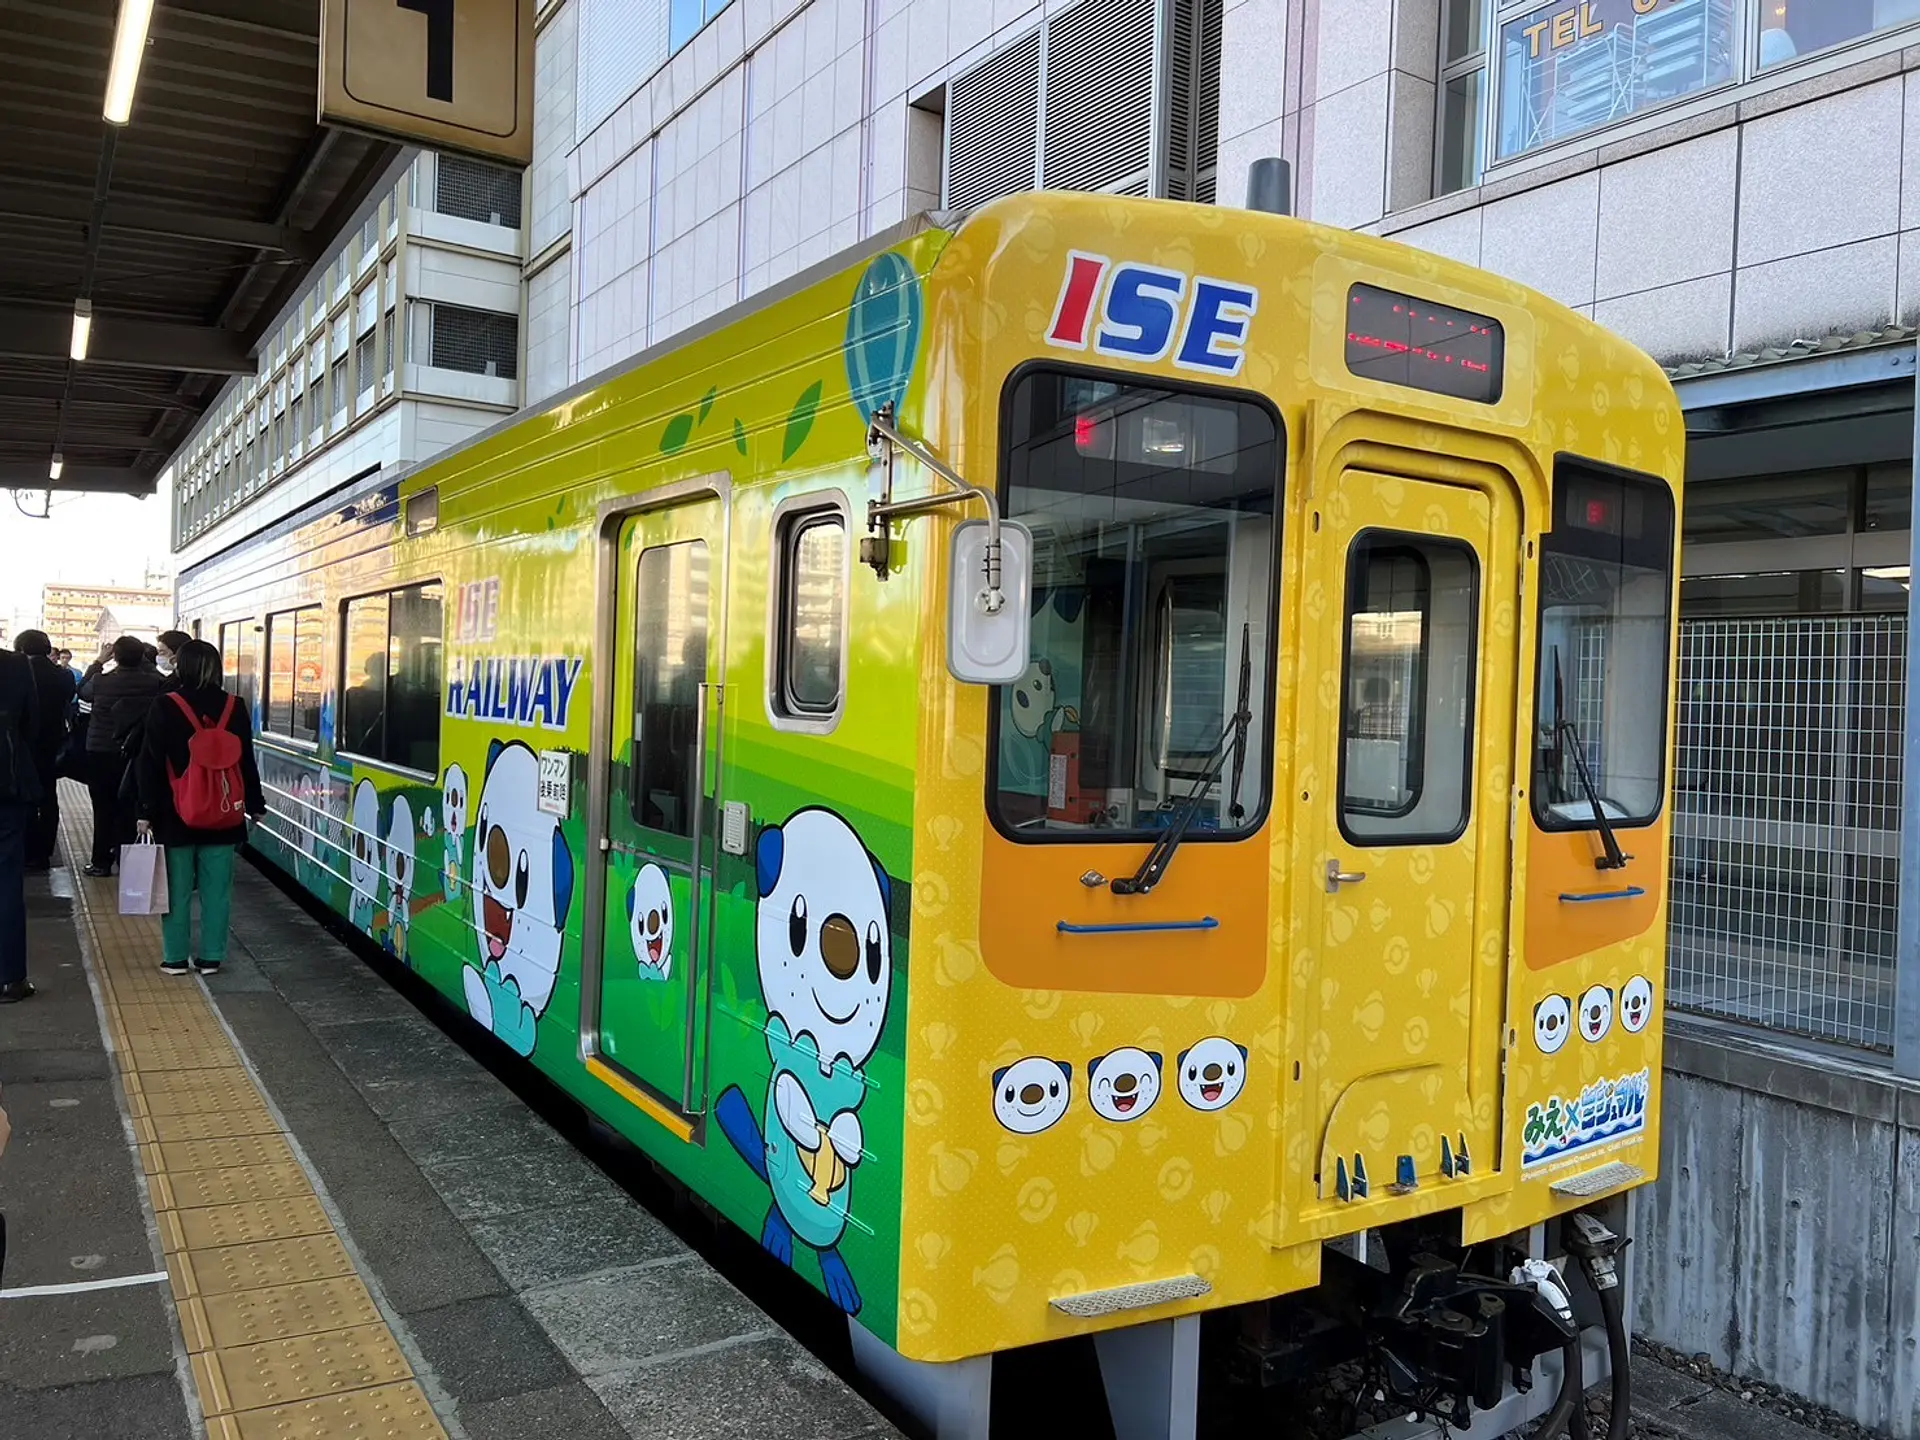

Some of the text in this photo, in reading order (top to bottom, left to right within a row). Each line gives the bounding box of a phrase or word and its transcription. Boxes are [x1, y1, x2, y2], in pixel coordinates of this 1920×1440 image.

[397, 0, 454, 104] 1
[1522, 2, 1603, 59] TEL
[1046, 252, 1257, 374] ISE
[455, 578, 499, 642] ISE
[446, 657, 582, 728] RAILWAY
[541, 757, 568, 778] ワンマン
